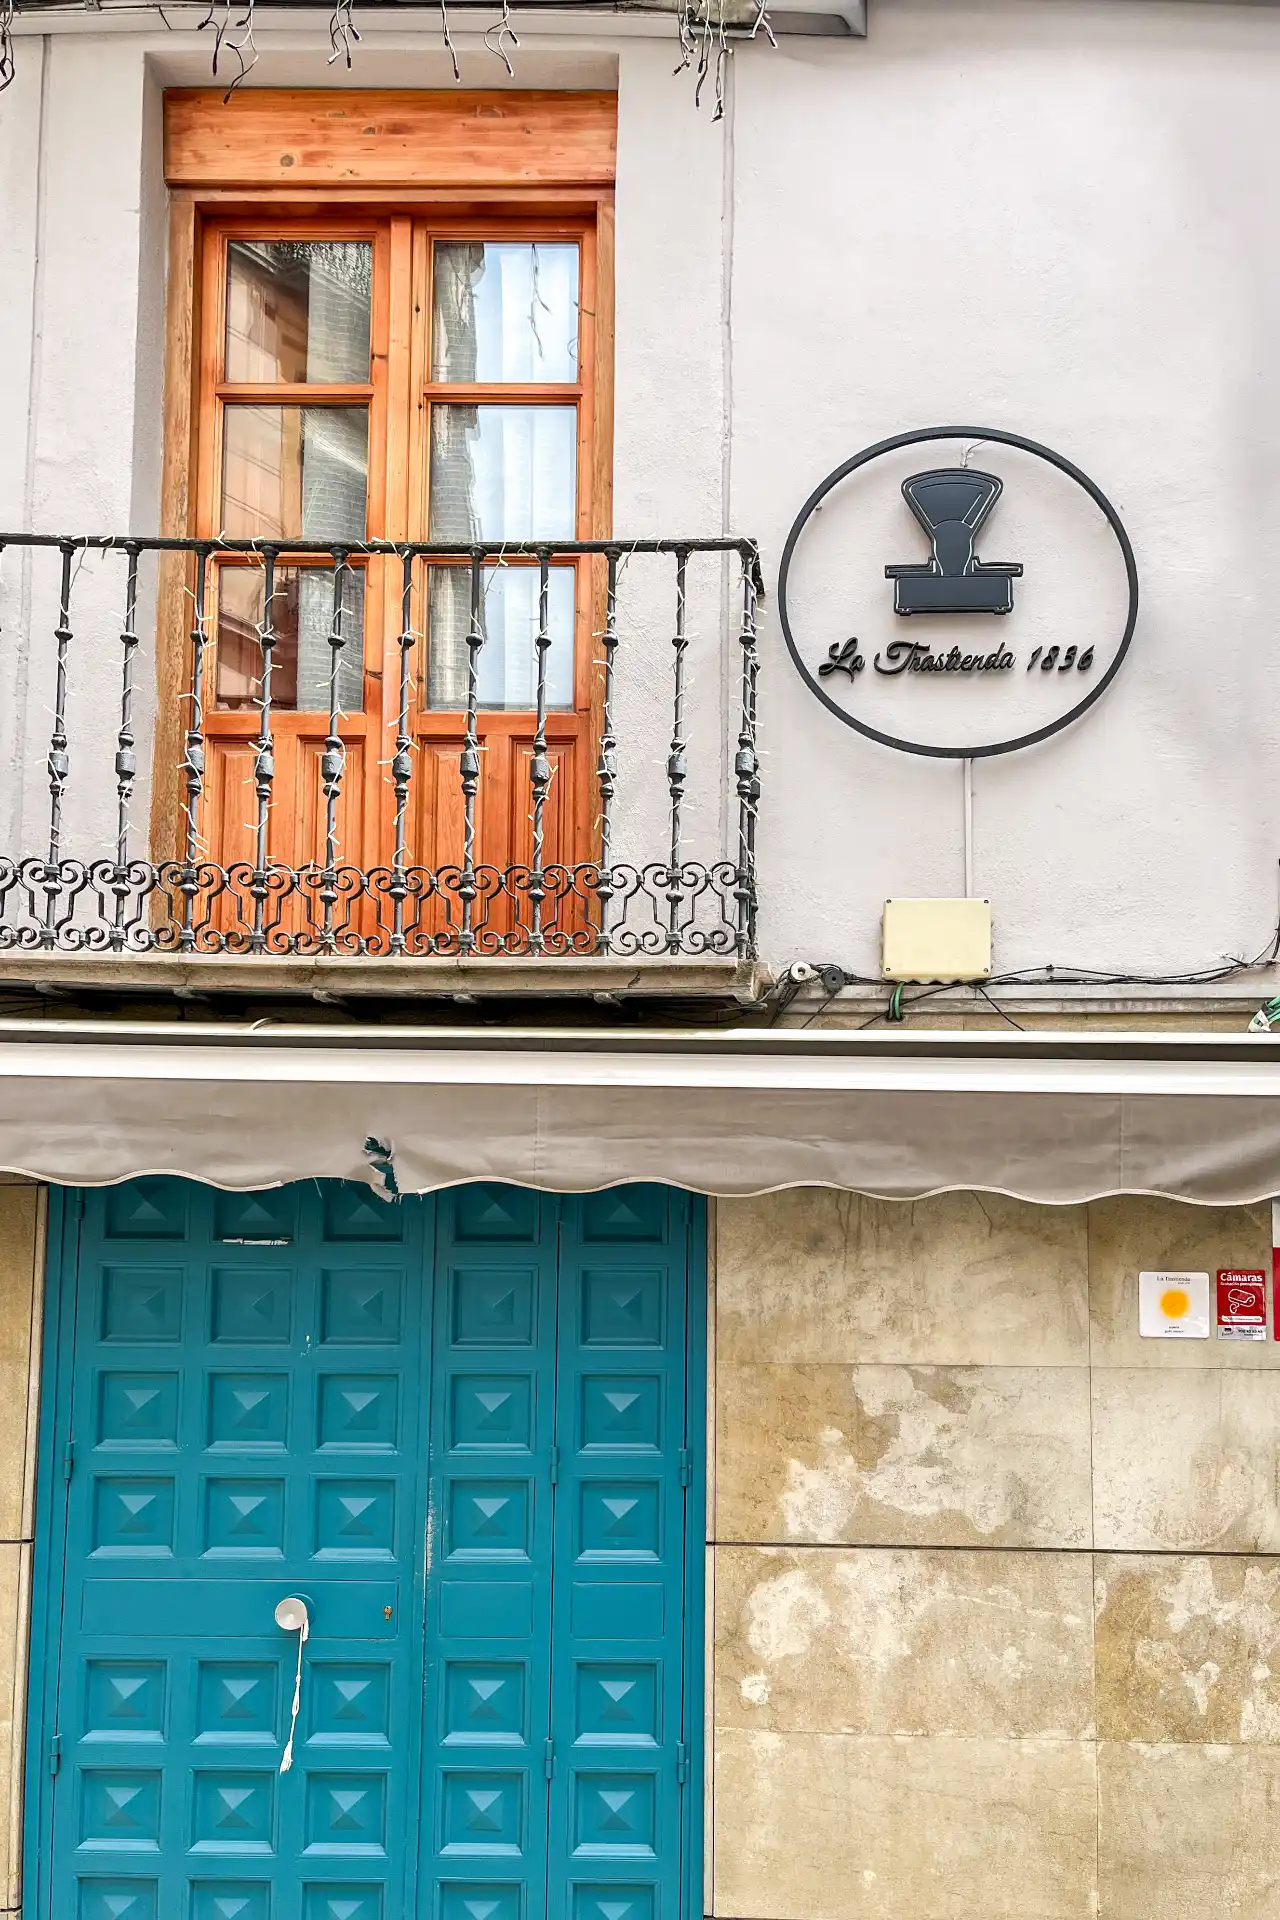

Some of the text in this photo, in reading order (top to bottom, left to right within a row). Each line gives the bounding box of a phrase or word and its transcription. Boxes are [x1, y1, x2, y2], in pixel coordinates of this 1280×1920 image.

[818, 637, 1096, 684] La Trastienda 1836
[1220, 1272, 1263, 1282] Cámaras
